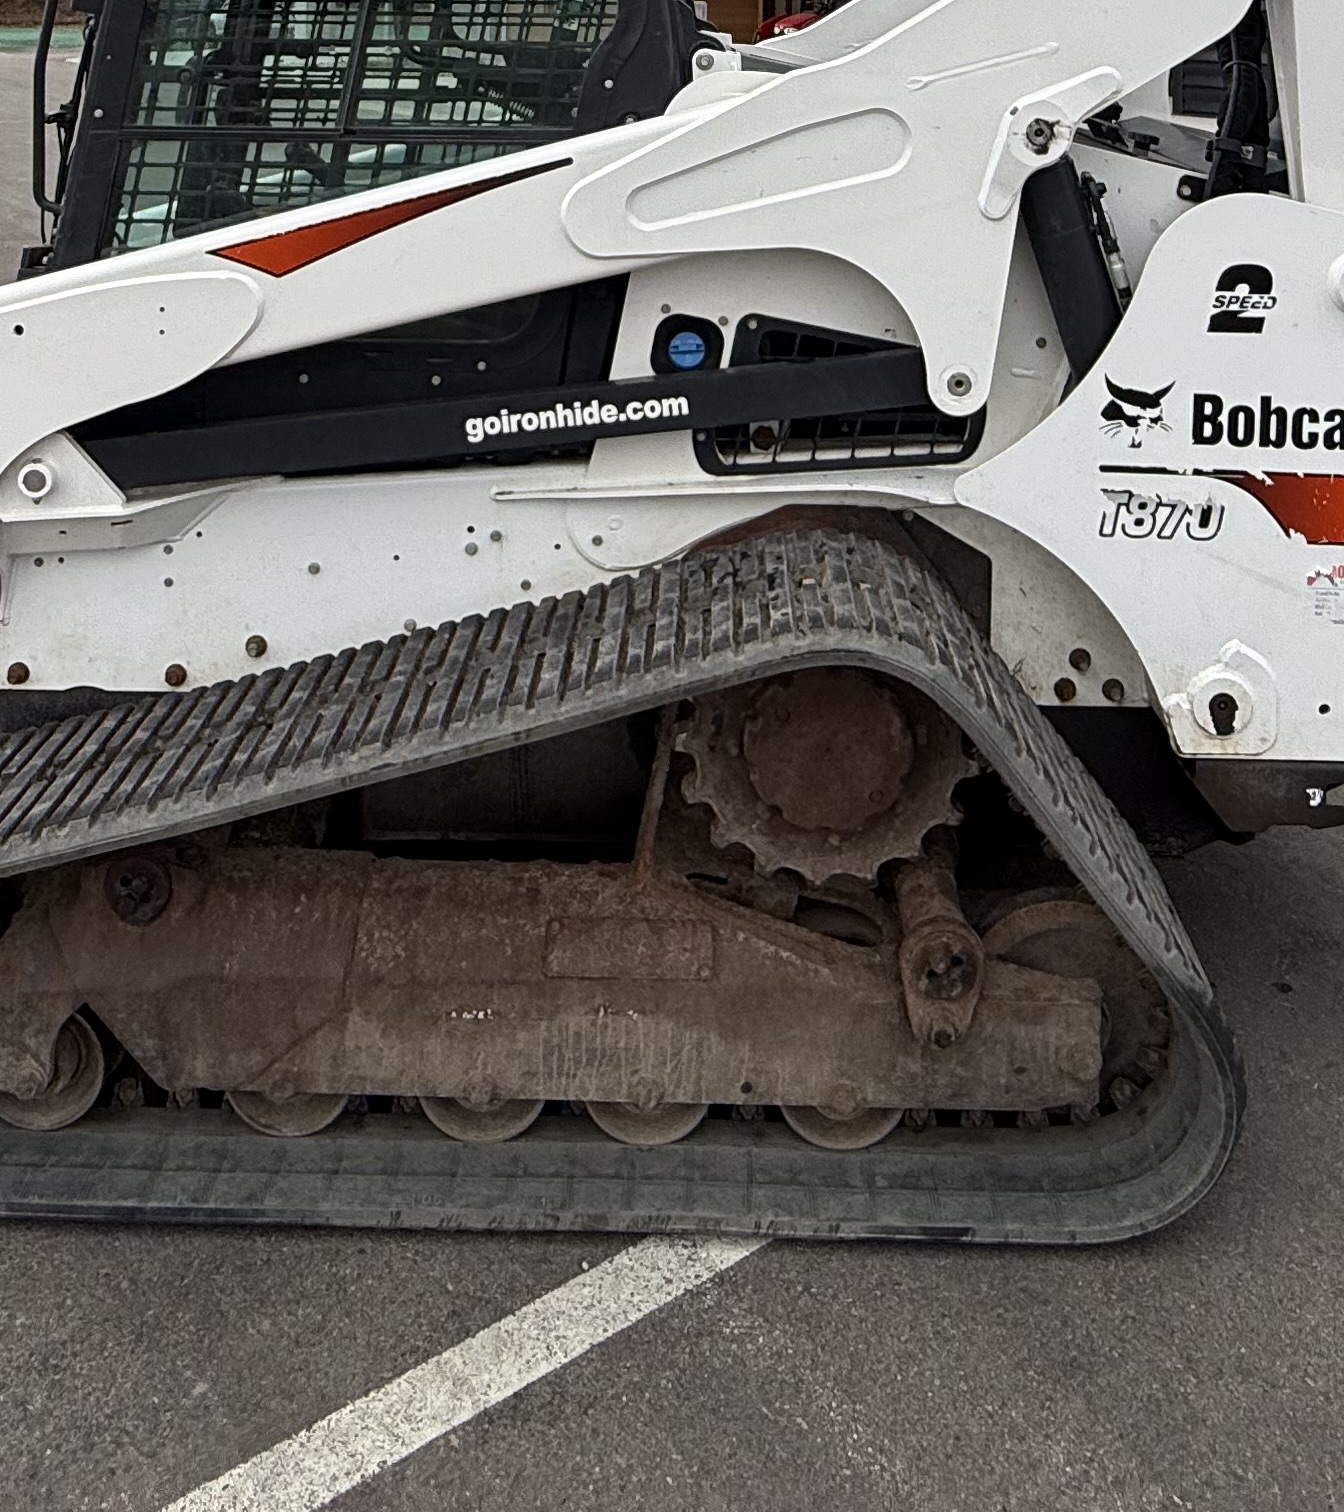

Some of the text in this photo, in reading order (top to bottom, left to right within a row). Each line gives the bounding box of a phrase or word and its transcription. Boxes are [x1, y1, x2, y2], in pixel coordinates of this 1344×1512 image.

[1212, 294, 1278, 309] SPEED
[465, 396, 689, 443] goironhide.com
[1099, 489, 1225, 541] T870
